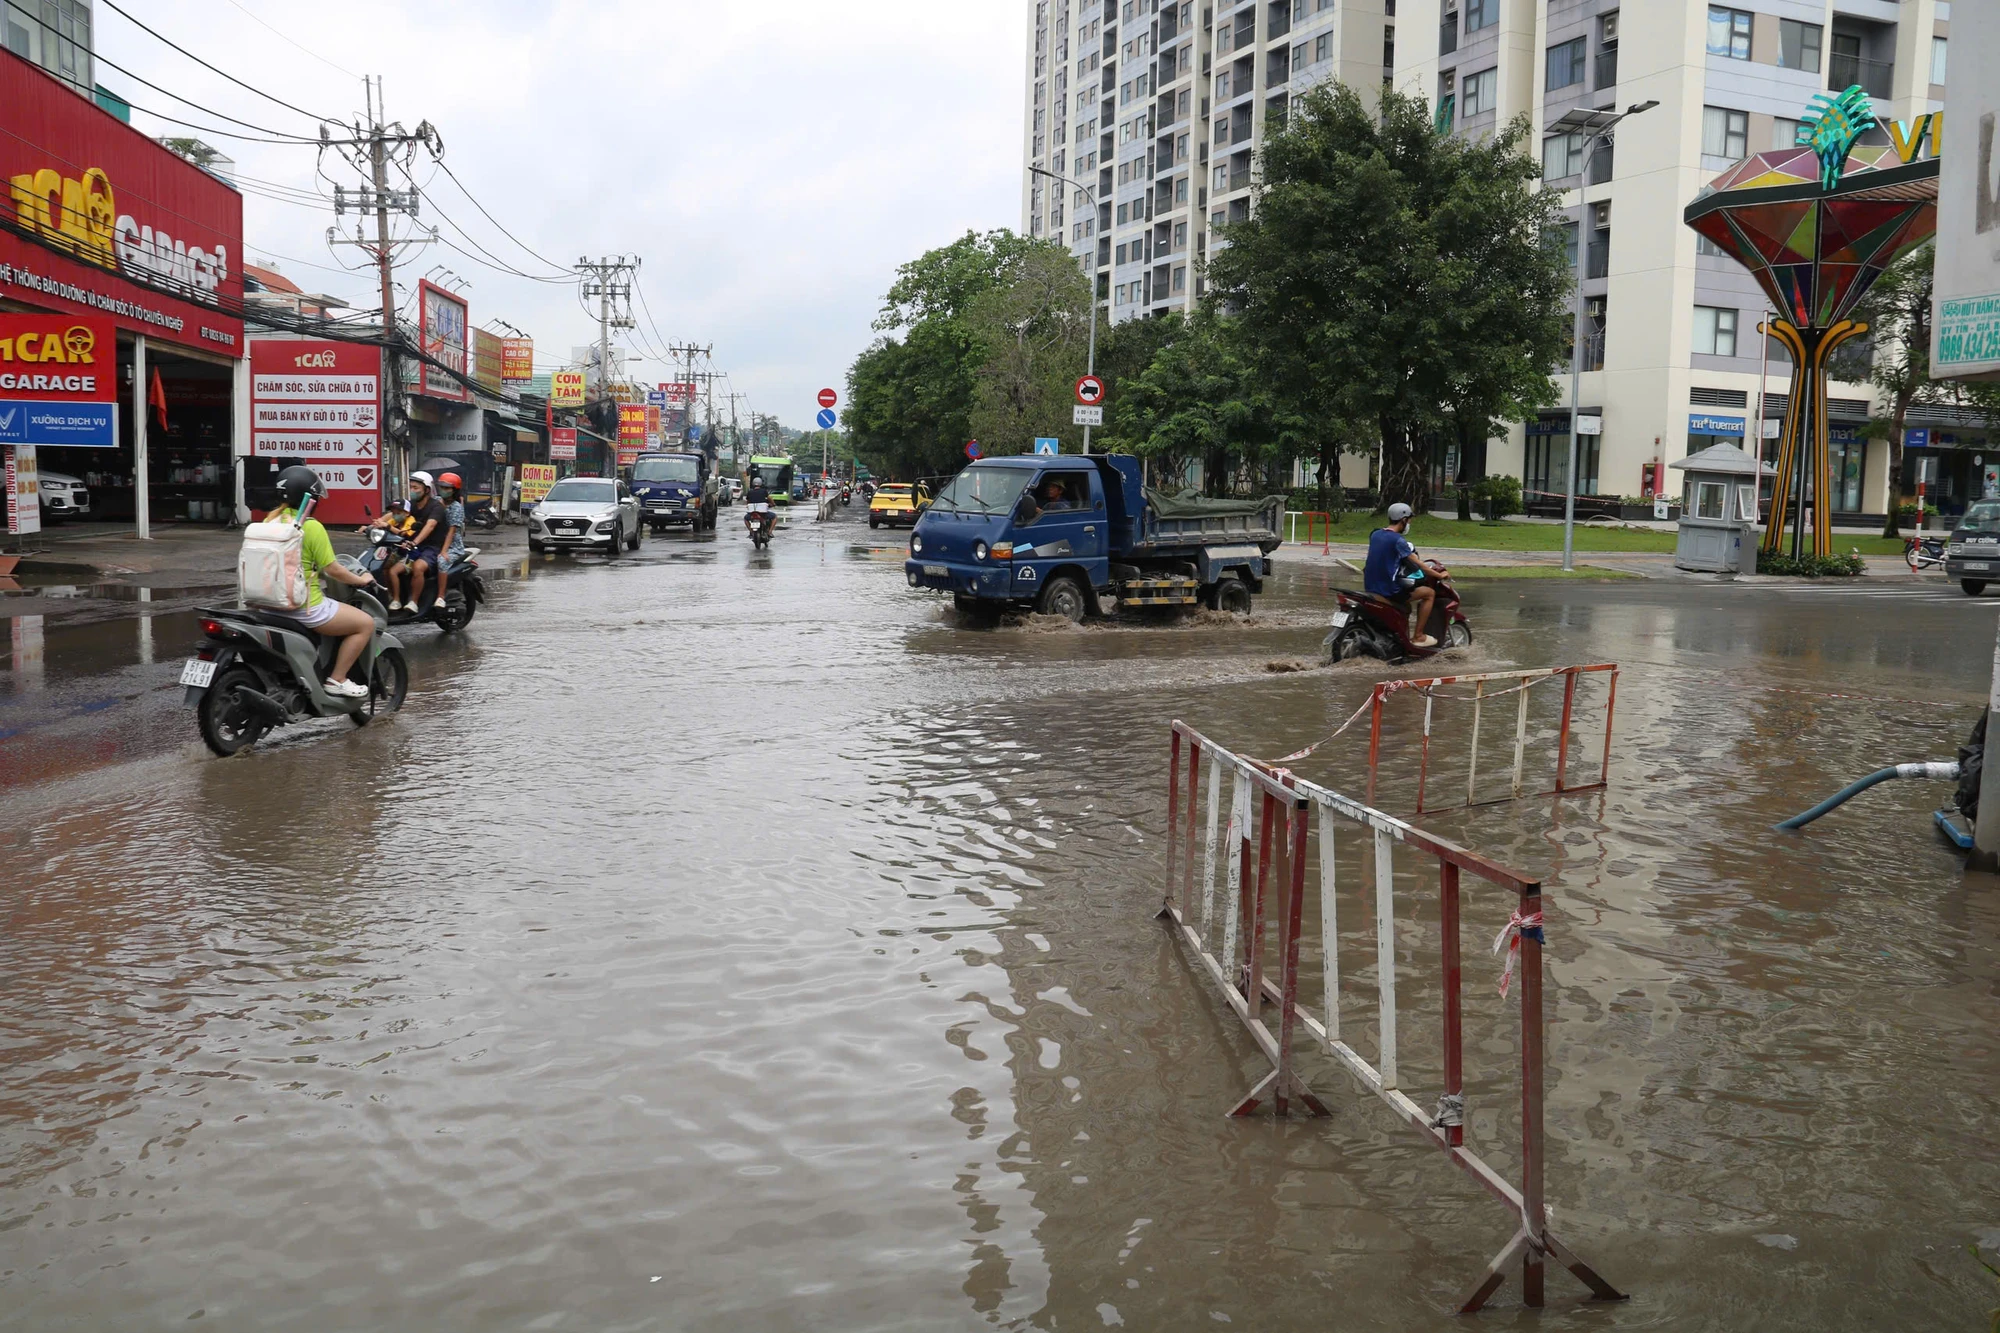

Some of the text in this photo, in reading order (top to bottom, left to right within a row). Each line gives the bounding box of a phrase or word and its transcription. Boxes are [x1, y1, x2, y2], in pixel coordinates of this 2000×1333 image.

[13, 266, 42, 290] THỐNG
[43, 276, 59, 295] BẢO
[60, 283, 86, 303] DƯỠNG
[87, 289, 97, 306] VÀ
[97, 294, 116, 312] CHĂM
[116, 298, 128, 316] SÓC
[129, 302, 134, 317] Ô
[135, 304, 142, 320] TÔ
[144, 309, 165, 326] CHUYÊN
[165, 316, 184, 333] NGHIỆP
[0, 373, 96, 392] GARAGE
[556, 374, 582, 384] CƠM
[257, 381, 283, 393] CHĂM
[308, 380, 326, 393] SỬA
[328, 381, 352, 393] CHỮA
[354, 381, 360, 393] Ô
[363, 381, 374, 393] TÔ
[556, 385, 581, 398] TẤM
[31, 413, 107, 427] XƯỞNG DỊCH VỤ
[259, 408, 348, 422] MUA BÁN KÝ GỬI Ô TÔ
[1691, 419, 1704, 429] TH
[259, 439, 343, 453] ĐÀO TẠO NGHỀ Ô TÔ
[6, 464, 16, 496] GARAGE
[325, 471, 345, 482] Ô TÔ
[523, 466, 554, 481] CƠM GÀ
[538, 481, 552, 489] NAM
